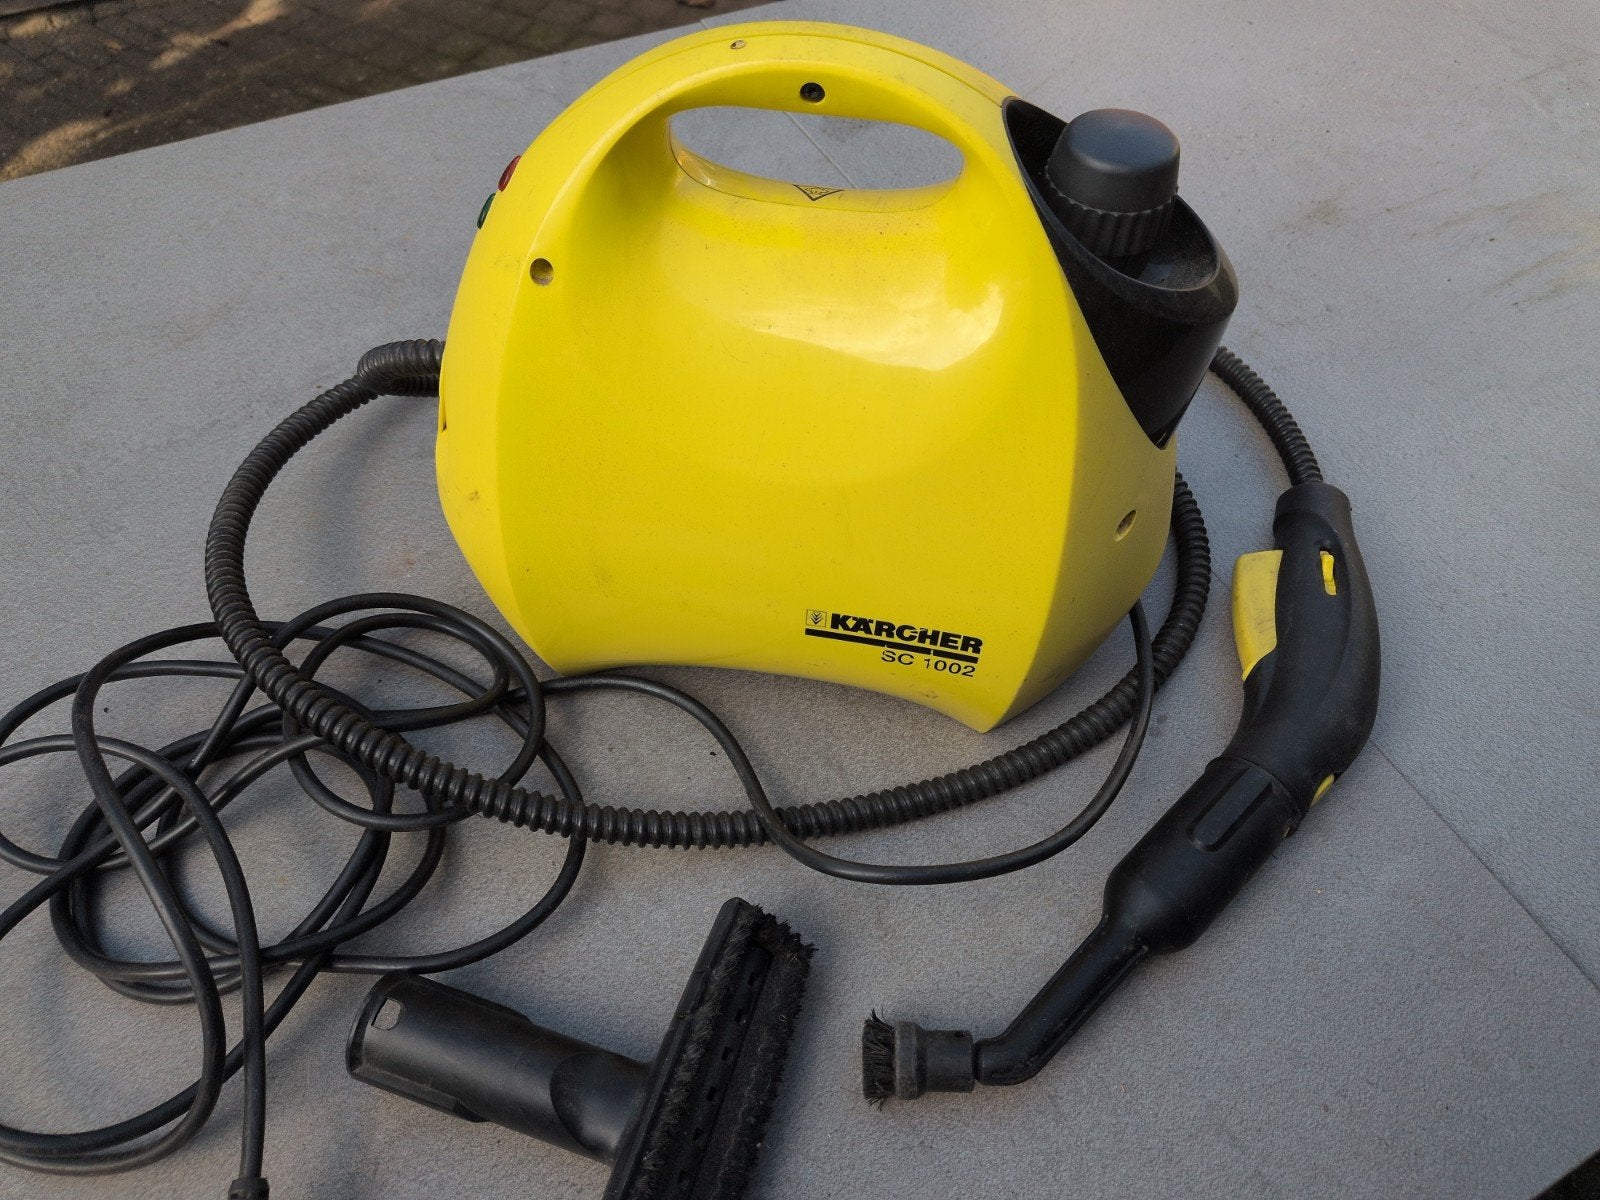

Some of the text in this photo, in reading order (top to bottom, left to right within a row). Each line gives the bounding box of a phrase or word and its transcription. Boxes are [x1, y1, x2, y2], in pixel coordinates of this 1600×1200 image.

[830, 613, 983, 654] KÄRCHER
[881, 650, 976, 677] SC 1002
